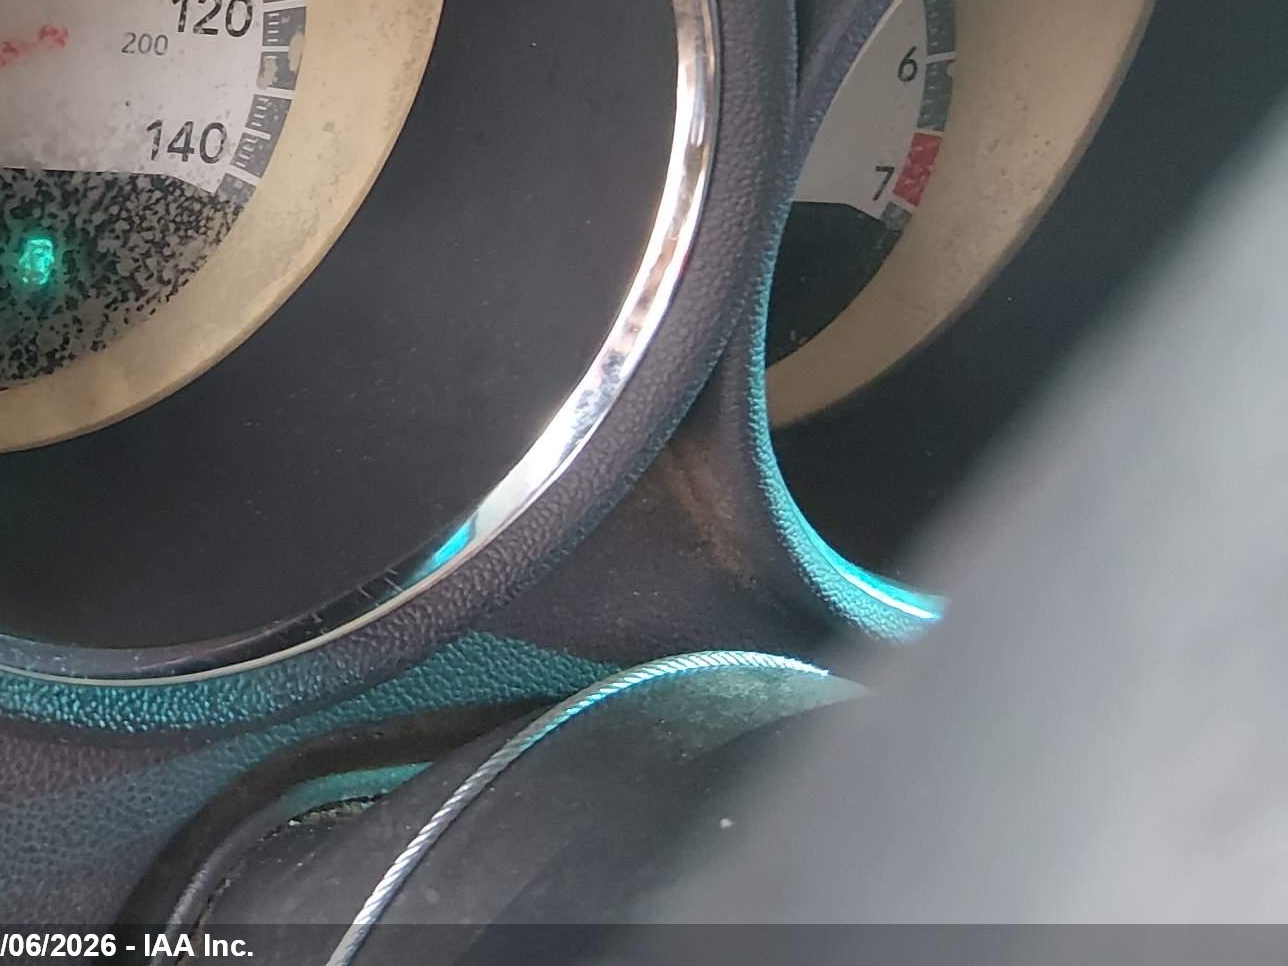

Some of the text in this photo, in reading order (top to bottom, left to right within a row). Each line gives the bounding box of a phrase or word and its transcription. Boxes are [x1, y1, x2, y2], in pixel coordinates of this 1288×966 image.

[120, 31, 169, 56] 200
[897, 46, 918, 83] 6
[145, 119, 229, 165] 140
[872, 165, 895, 201] 7
